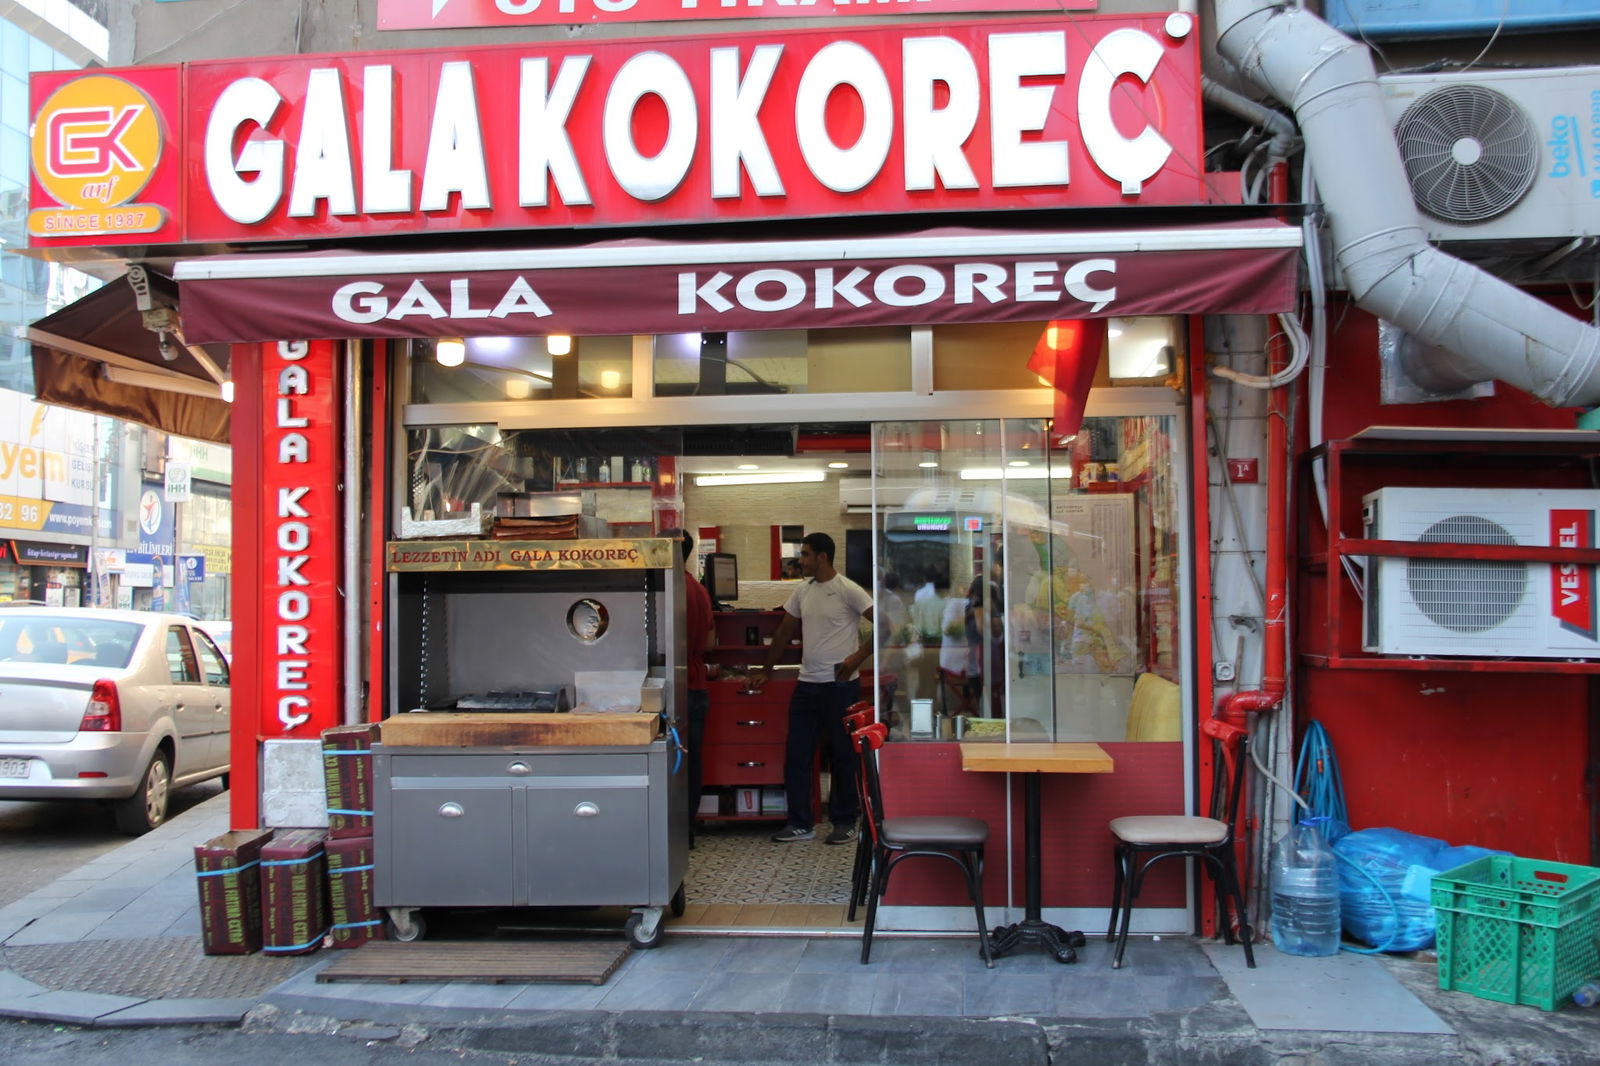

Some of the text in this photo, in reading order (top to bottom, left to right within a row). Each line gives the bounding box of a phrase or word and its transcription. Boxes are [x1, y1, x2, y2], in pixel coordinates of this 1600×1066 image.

[203, 28, 1173, 224] GALA KOKOREÇ
[1547, 114, 1571, 178] beko
[105, 213, 145, 227] 1987
[332, 259, 1117, 324] GALA KOKOREÇ
[21, 505, 38, 523] 96
[276, 340, 311, 731] GALA KOKOREÇ
[391, 549, 639, 563] LEZZETİN ADI GALA KOKOREÇ
[1559, 522, 1579, 606] VESEL
